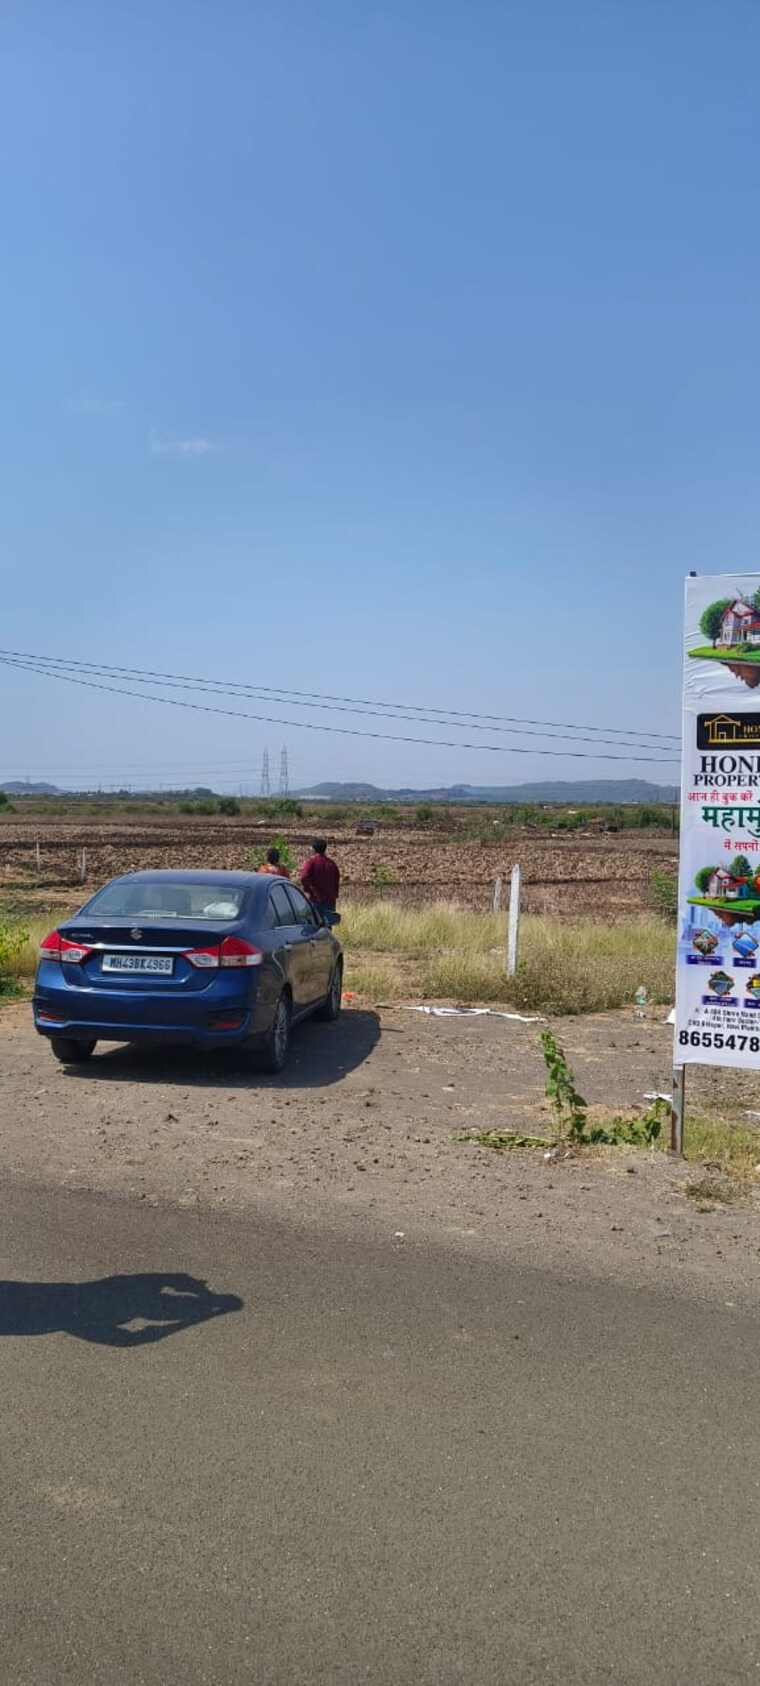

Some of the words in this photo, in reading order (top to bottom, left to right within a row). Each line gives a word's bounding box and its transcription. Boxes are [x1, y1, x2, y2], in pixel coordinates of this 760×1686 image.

[694, 774, 760, 787] PROPER
[734, 839, 759, 851] सपनों
[679, 1030, 760, 1053] 8655478
